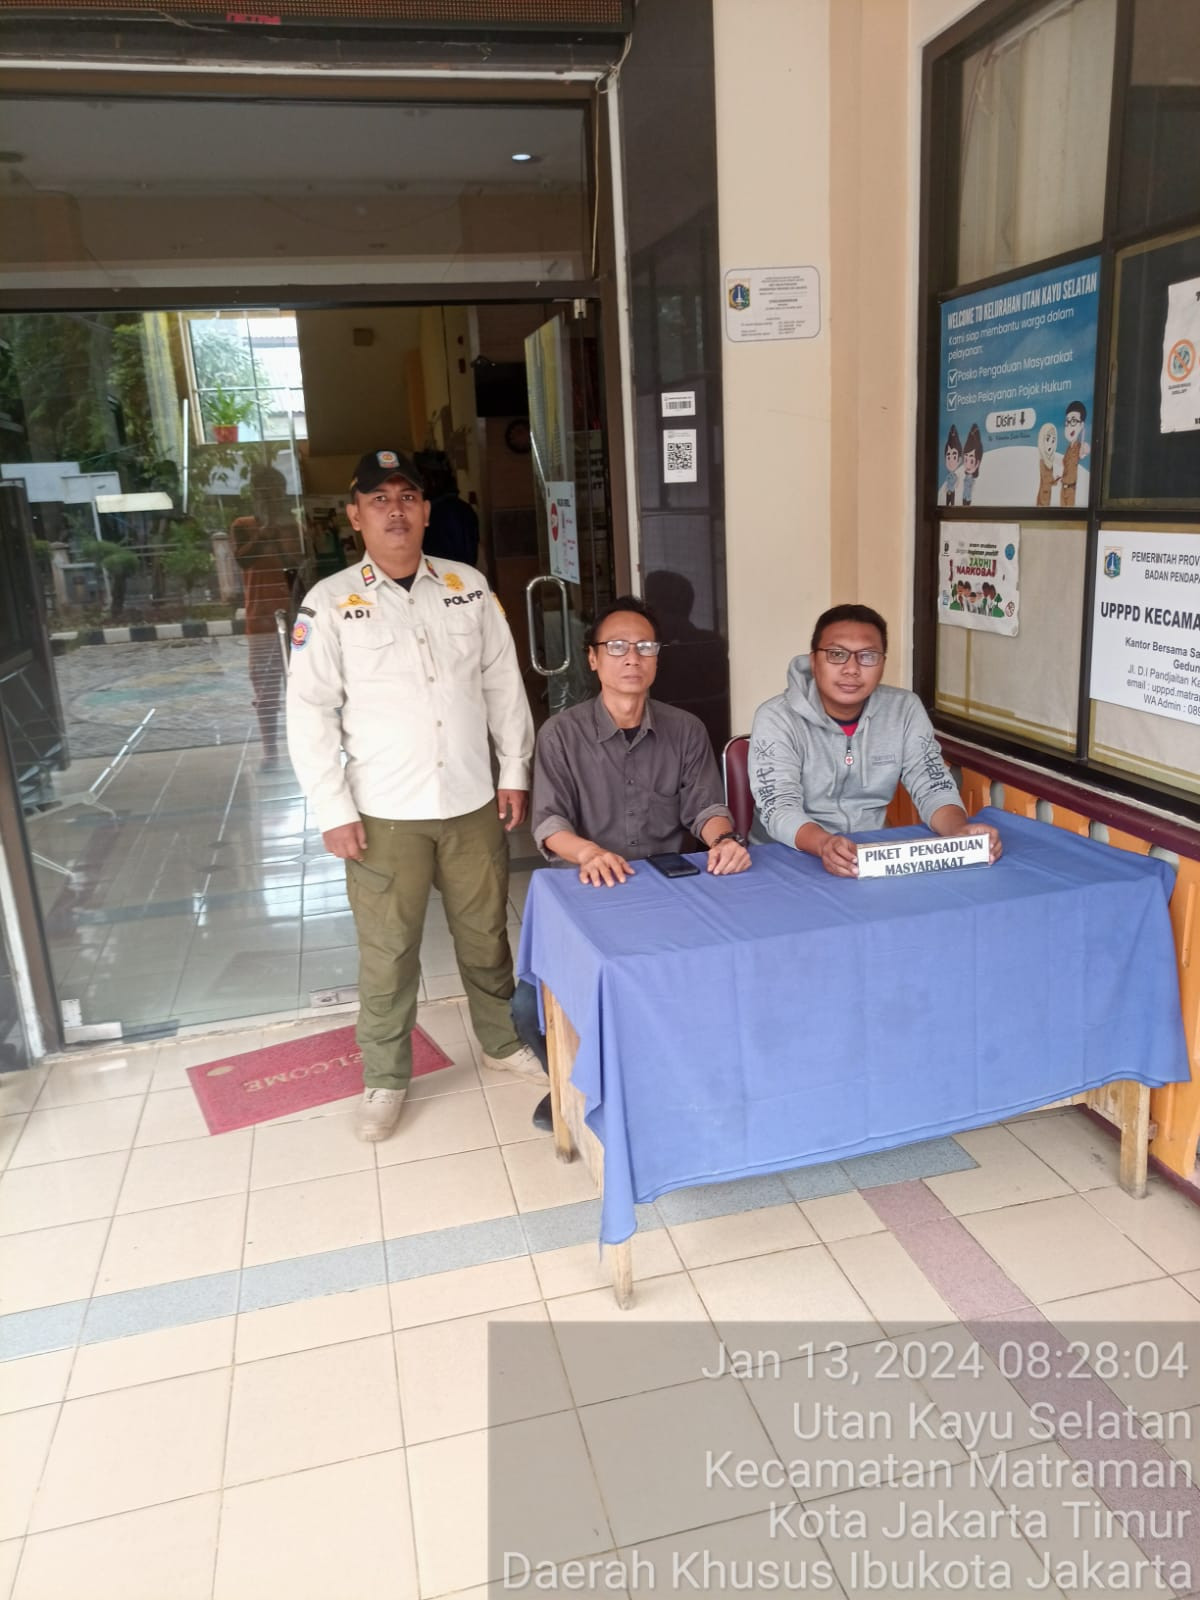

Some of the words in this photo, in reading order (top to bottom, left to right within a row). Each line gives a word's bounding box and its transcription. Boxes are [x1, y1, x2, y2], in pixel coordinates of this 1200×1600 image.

[948, 307, 975, 330] WELCOME
[976, 304, 983, 322] TO
[984, 294, 1021, 320] KELURAHAN
[1022, 288, 1041, 311] UTAN
[1041, 281, 1061, 305] KAYU
[1063, 272, 1097, 300] SELATAN
[949, 332, 964, 345] Kami
[981, 321, 1020, 337] membantu
[1021, 314, 1046, 329] warga
[1047, 308, 1075, 323] dalam
[979, 360, 1022, 379] Pengaduan
[1023, 349, 1073, 370] Masyarakat
[978, 388, 1017, 404] Pelayanan
[1041, 379, 1072, 393] Hukum
[996, 414, 1016, 428] Disini
[1132, 551, 1177, 564] PEMERINTAH
[1145, 569, 1169, 581] BADAN
[1101, 601, 1140, 622] UPPPD
[1125, 637, 1150, 649] Kantor
[1153, 641, 1188, 656] Bersama
[1150, 668, 1189, 685] Pandjaitan
[1127, 679, 1146, 690] email
[1152, 684, 1200, 703] upppd.matra
[1144, 693, 1156, 706] WA
[1158, 697, 1181, 712] Admin
[865, 848, 901, 861] PIKET
[910, 839, 983, 856] PENGADUAN
[885, 856, 964, 876] MASYARAKAT
[243, 1052, 363, 1093] ELCOME
